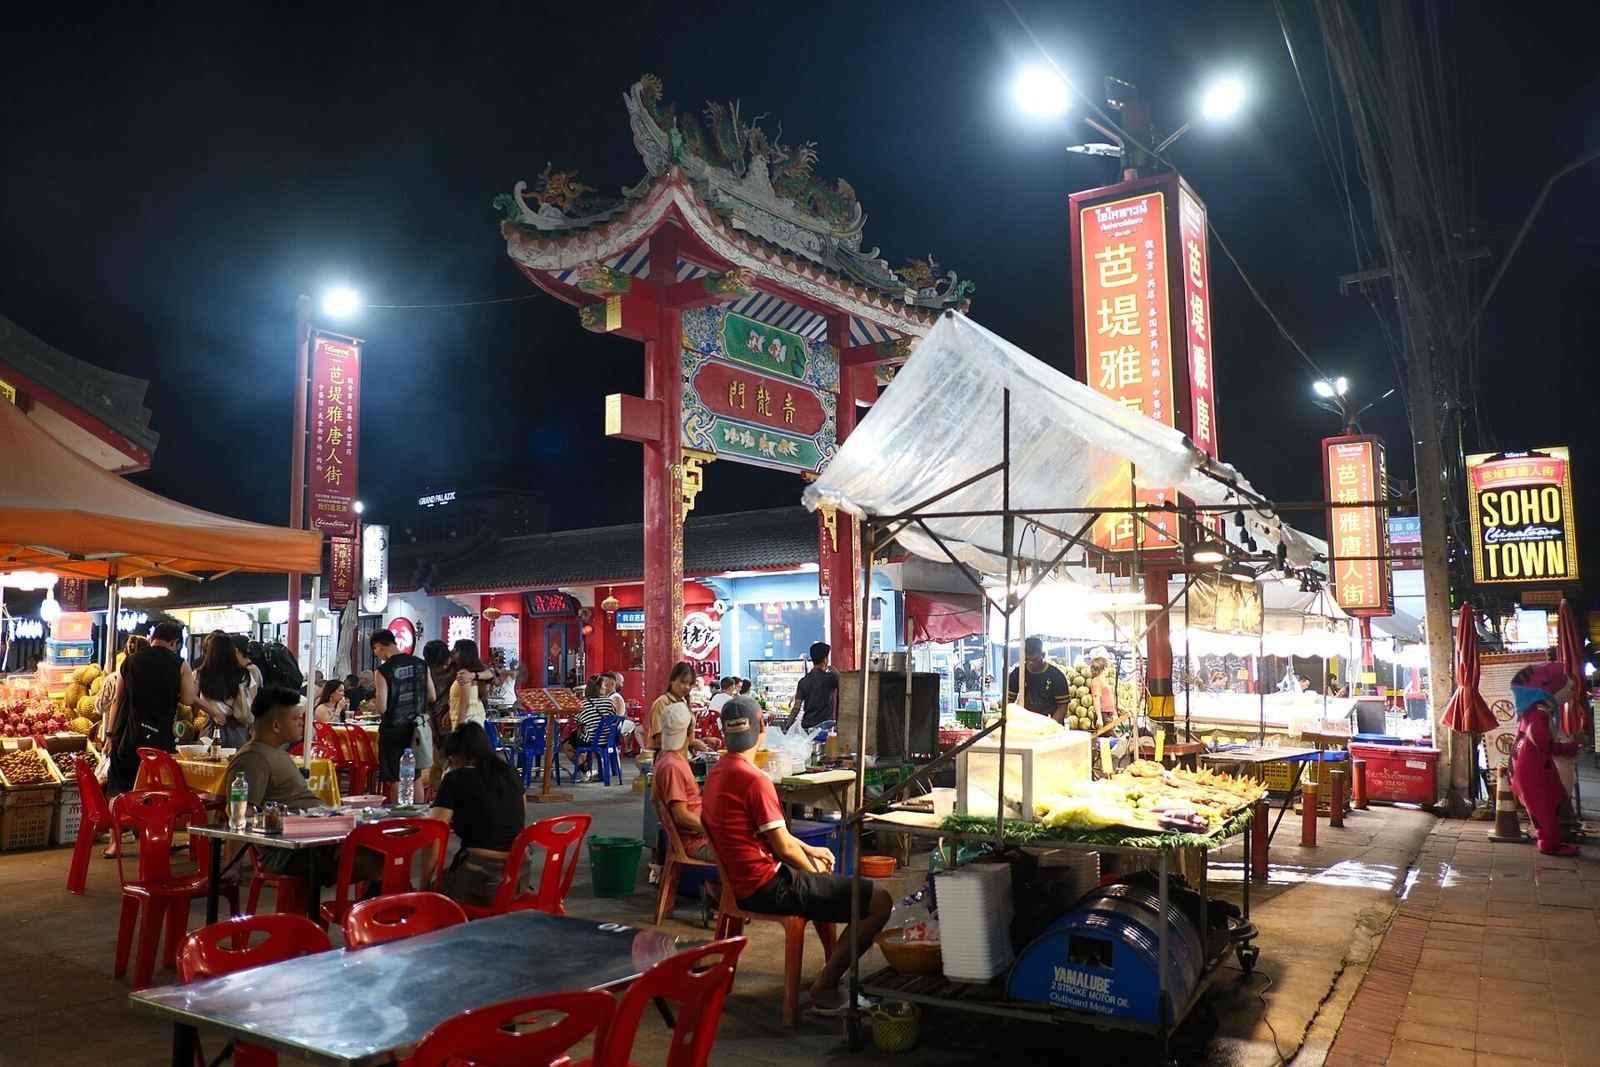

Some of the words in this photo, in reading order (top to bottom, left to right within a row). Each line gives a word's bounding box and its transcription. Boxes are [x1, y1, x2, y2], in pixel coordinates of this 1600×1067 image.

[323, 366, 345, 487] 芭堤雅唐人街
[418, 495, 435, 505] GRAND
[1481, 487, 1561, 527] SOHO
[1484, 525, 1562, 543] Chinatown
[1484, 540, 1565, 578] TOWN
[1051, 981, 1057, 990] 2
[1057, 983, 1088, 998] STROKE
[1088, 991, 1116, 1004] MOTOR
[1053, 965, 1111, 994] YAMALUBE
[1050, 991, 1088, 1008] Outboard
[1089, 1002, 1114, 1014] Motor
